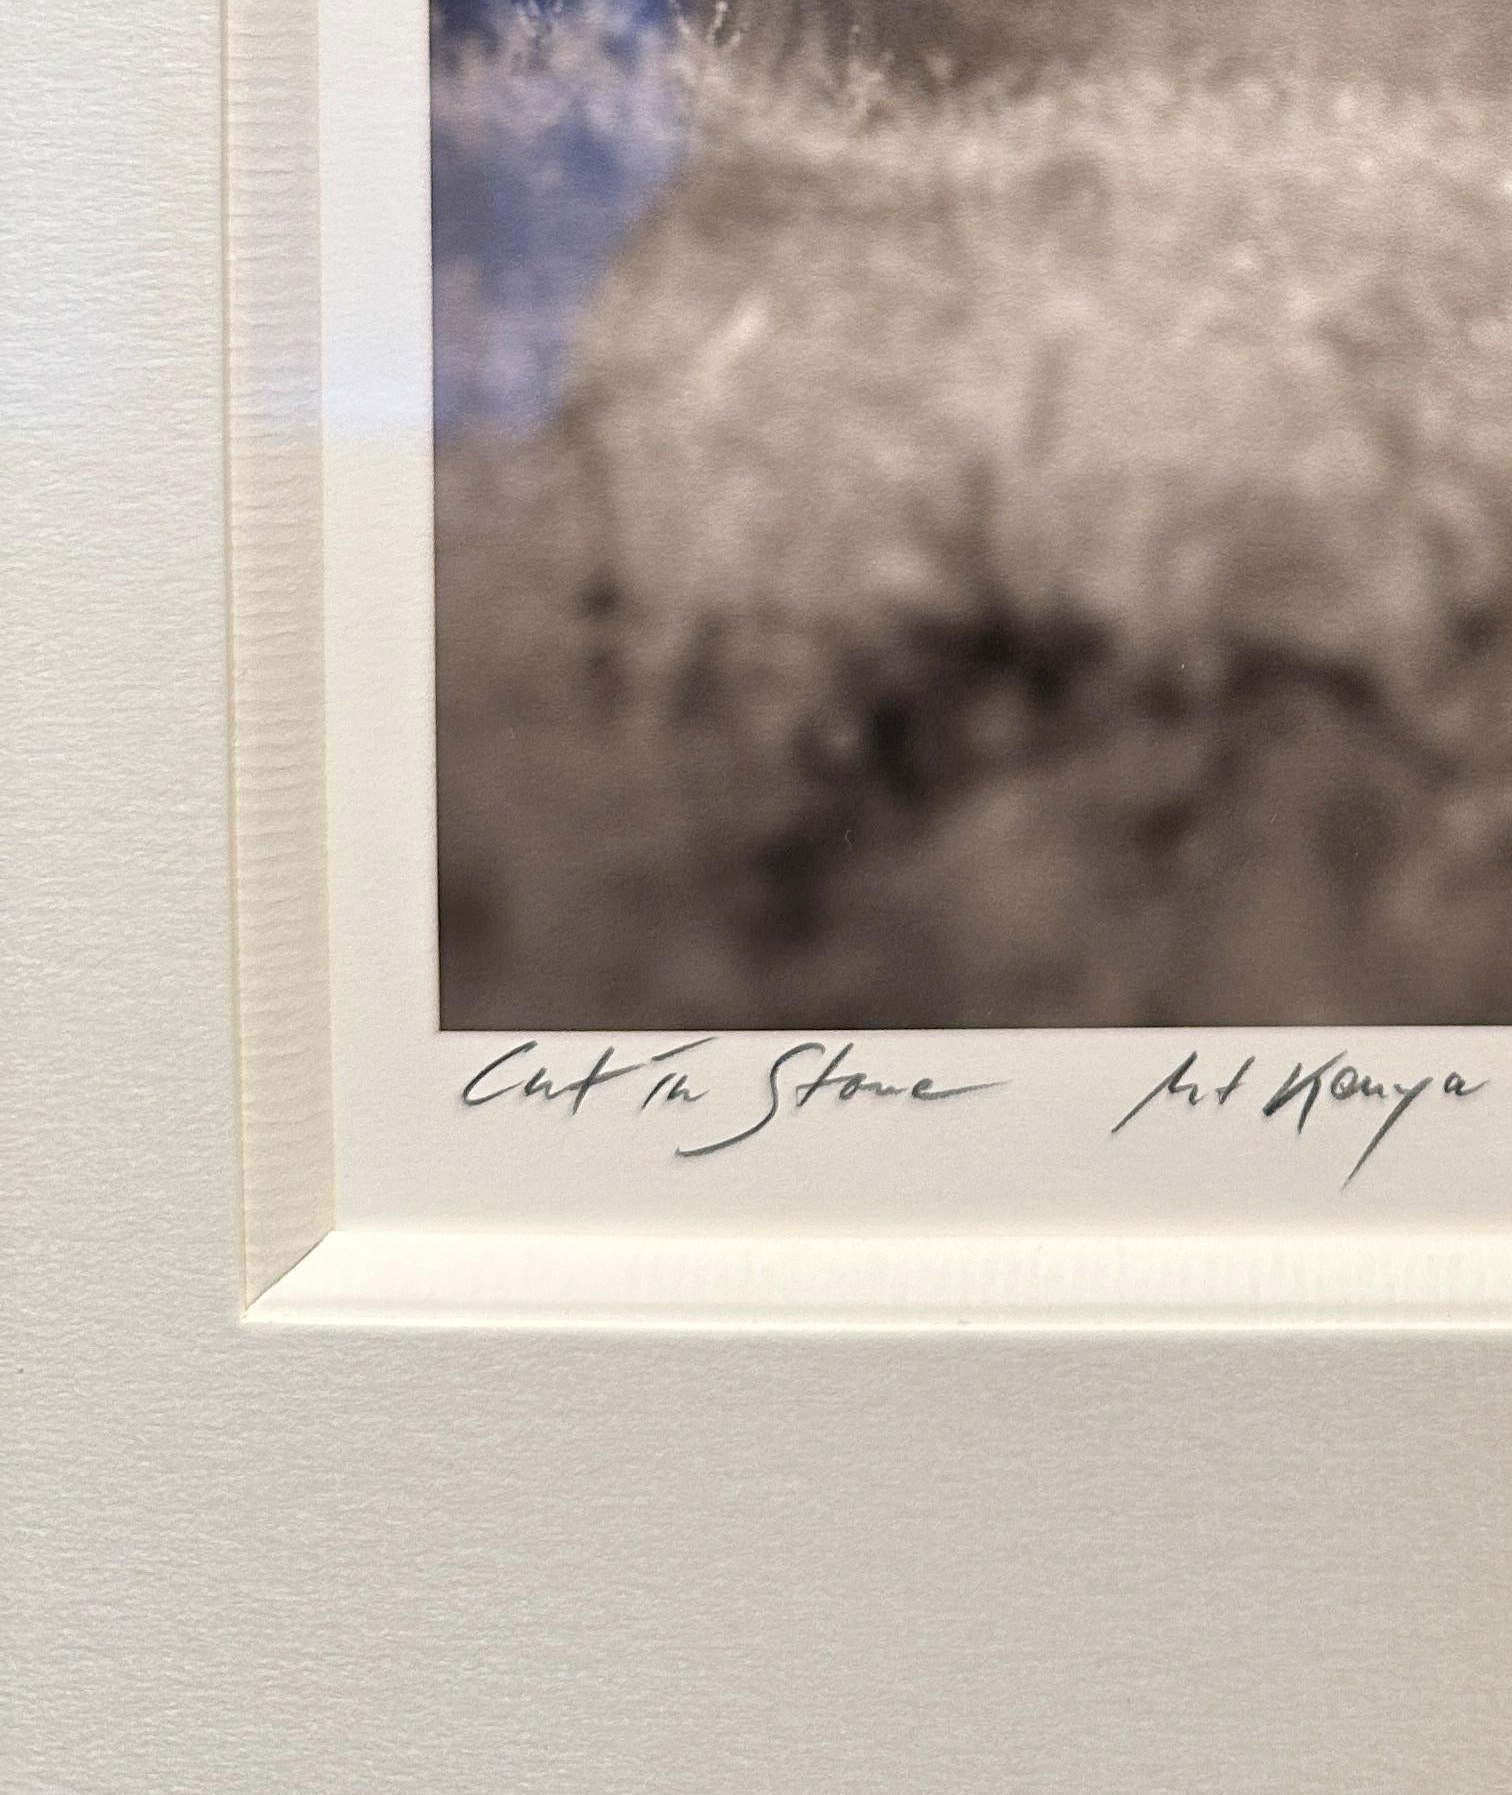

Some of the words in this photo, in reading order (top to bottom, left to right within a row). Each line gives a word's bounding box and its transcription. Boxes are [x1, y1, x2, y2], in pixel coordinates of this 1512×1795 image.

[459, 1040, 641, 1116] Cut
[640, 1036, 717, 1112] in
[674, 1042, 1002, 1160] Stone
[1110, 1049, 1256, 1136] Mt
[1261, 1049, 1490, 1187] Kenya
